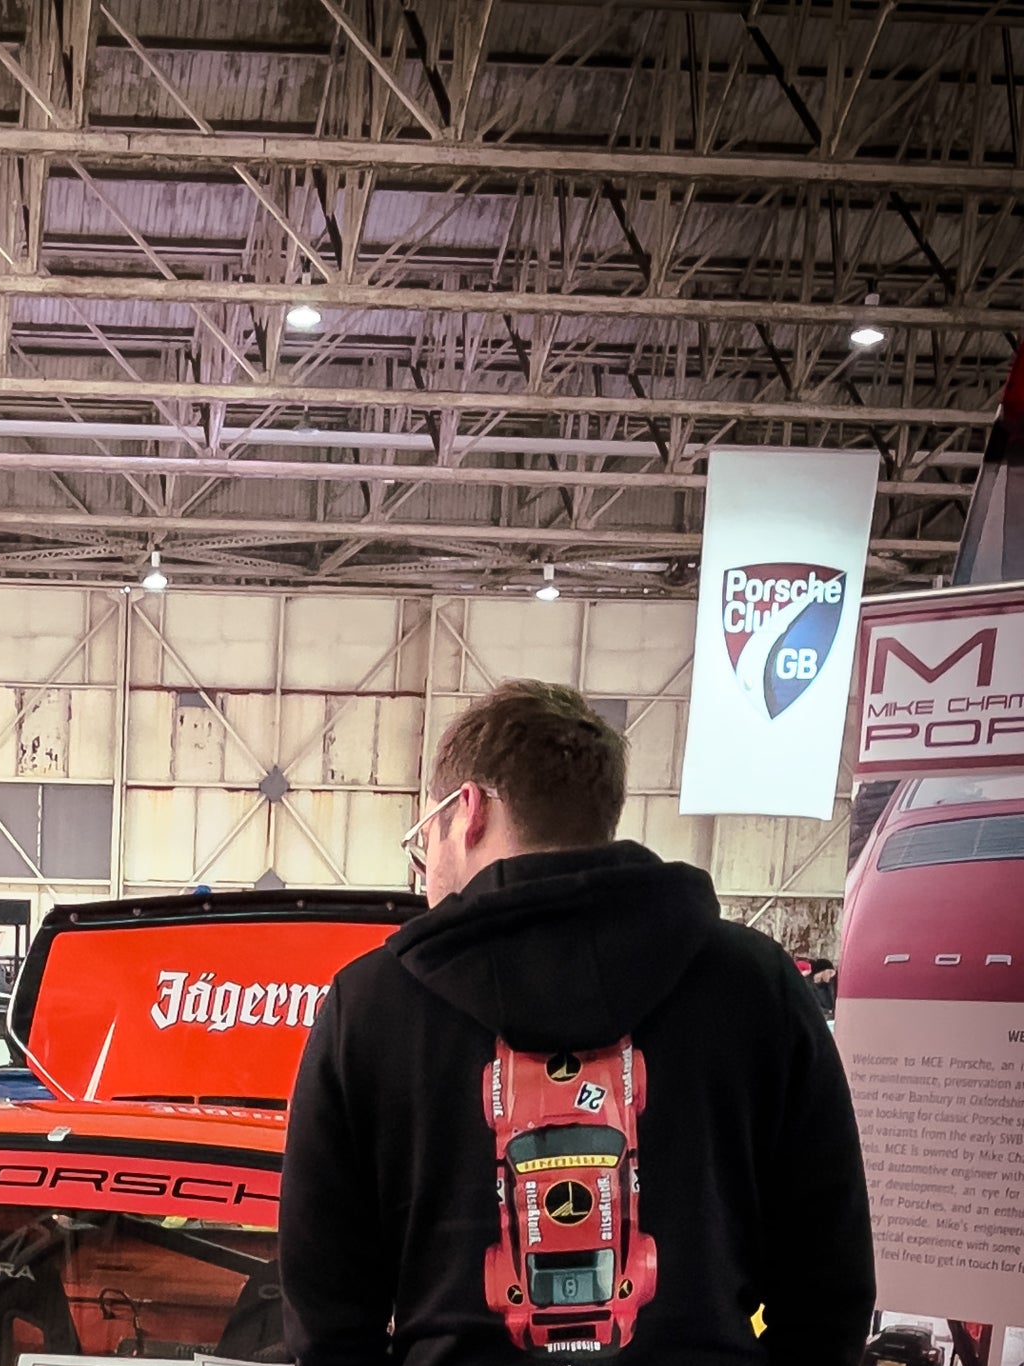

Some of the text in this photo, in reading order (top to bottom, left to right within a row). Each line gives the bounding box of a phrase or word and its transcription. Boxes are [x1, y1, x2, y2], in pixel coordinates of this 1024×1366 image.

[726, 570, 842, 604] Porsche
[776, 648, 818, 680] GB
[868, 700, 934, 719] MIKE
[904, 1056, 915, 1067] to
[921, 1056, 944, 1068] MCE
[1001, 1061, 1015, 1071] an
[579, 1084, 606, 1110] 24
[972, 1112, 1015, 1127] Porsche
[949, 1129, 967, 1142] the
[999, 1132, 1023, 1146] SWB
[884, 1144, 907, 1155] MCE
[951, 1203, 972, 1214] and
[976, 1206, 989, 1216] an
